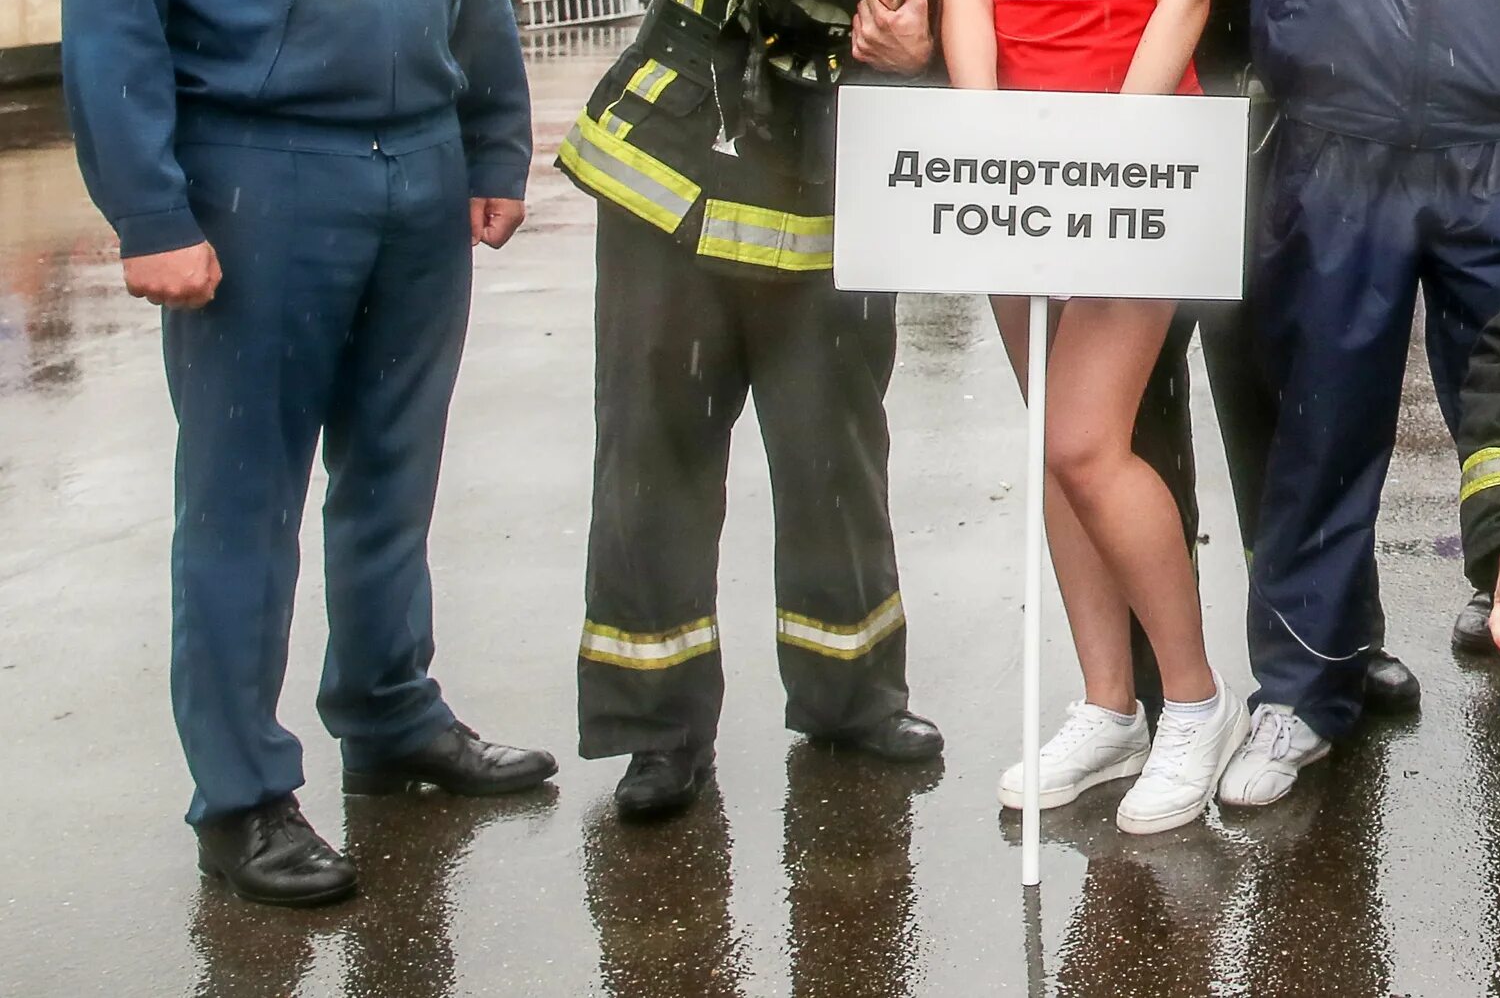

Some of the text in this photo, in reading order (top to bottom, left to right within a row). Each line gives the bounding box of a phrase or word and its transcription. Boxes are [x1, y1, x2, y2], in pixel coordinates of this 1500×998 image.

[888, 149, 1200, 195] Департамент
[932, 203, 1166, 240] ГОЧС и ПБ
